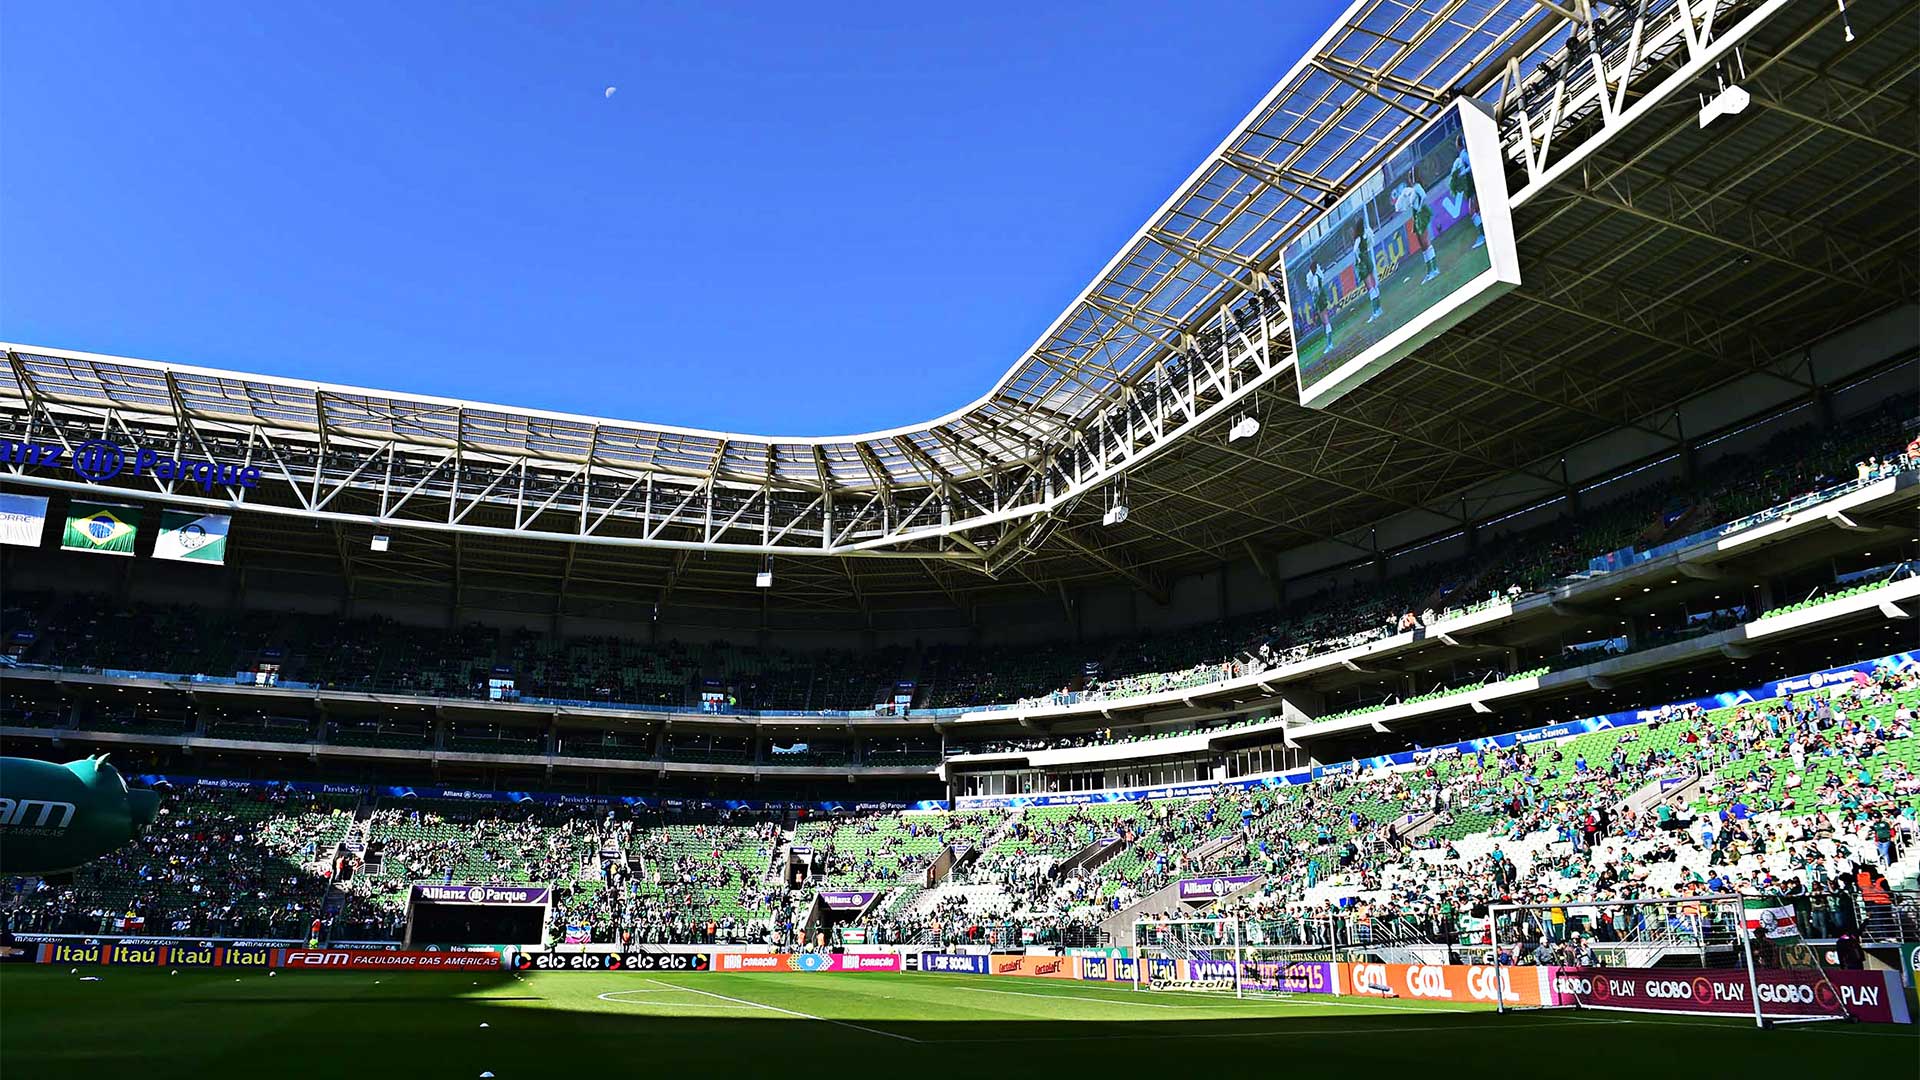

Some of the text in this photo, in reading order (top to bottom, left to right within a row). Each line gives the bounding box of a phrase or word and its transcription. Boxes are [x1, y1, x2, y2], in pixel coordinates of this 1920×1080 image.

[134, 447, 260, 492] Parque
[887, 802, 907, 810] Parque
[421, 887, 527, 903] Allianz Parque
[1184, 882, 1212, 895] Allianz
[56, 945, 99, 962] Itaú
[113, 946, 155, 963] Itaú
[170, 947, 212, 964] Itaú
[225, 949, 267, 965] Itaú
[353, 956, 416, 965] FACULDADE
[419, 956, 441, 966] DAS
[536, 955, 566, 969] elo
[570, 953, 600, 969] elo
[625, 953, 654, 969] elo
[658, 954, 687, 969] elo
[1084, 959, 1106, 979] Itaú
[1115, 960, 1134, 981] Ita
[1149, 959, 1175, 981] Itaú
[1284, 964, 1325, 989] 10315
[1353, 964, 1393, 995] GOL
[1406, 965, 1452, 998] GOL
[1467, 966, 1519, 1001] GOL
[1553, 977, 1635, 997] GLOBO PLAY
[1645, 980, 1745, 1001] GLOBO PLAY
[1757, 983, 1879, 1006] GLOBO PLAY
